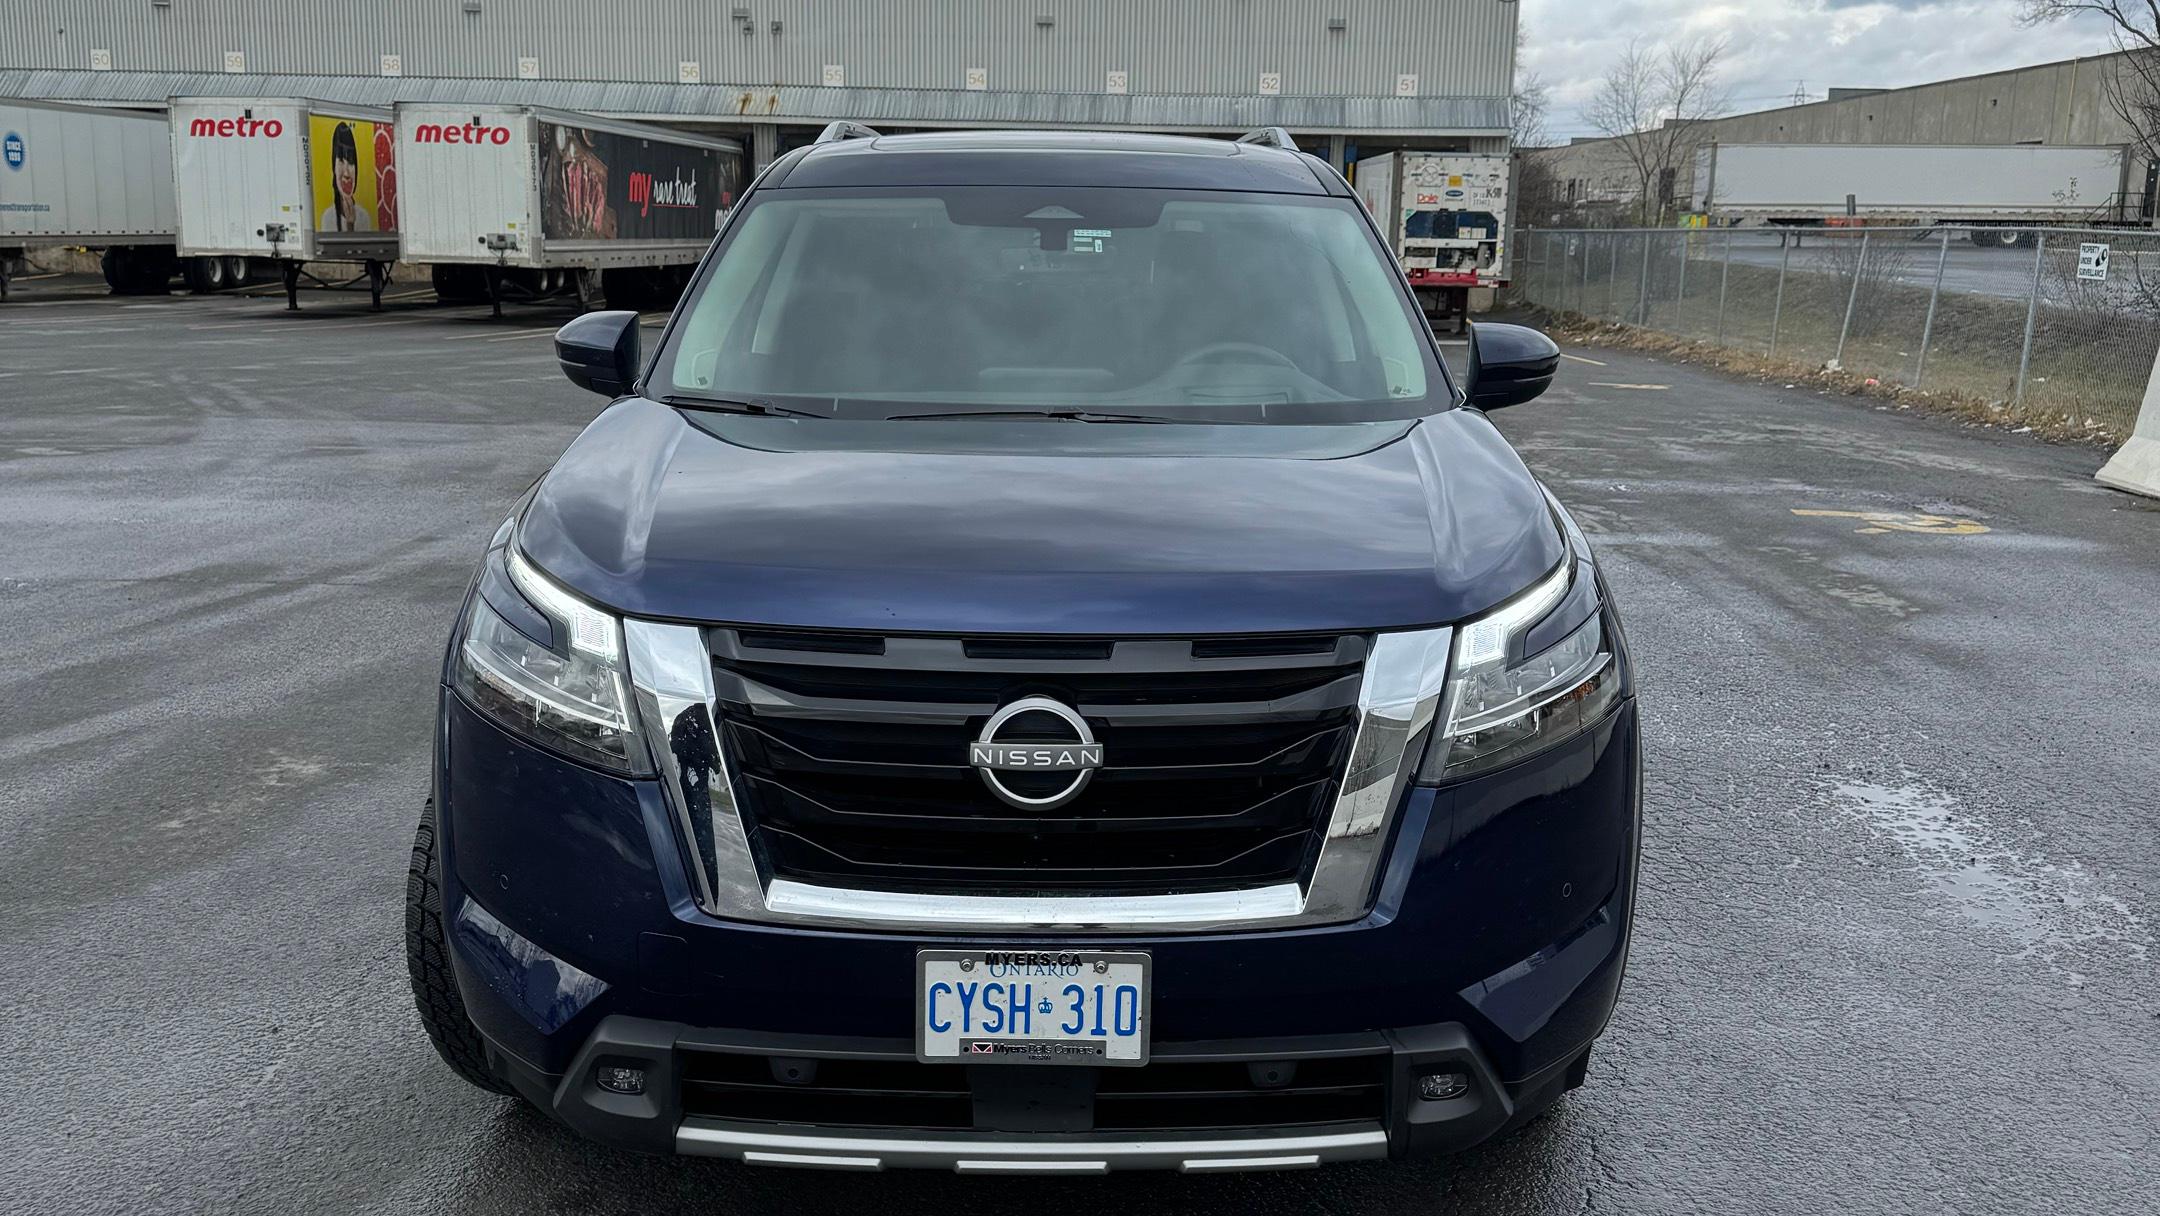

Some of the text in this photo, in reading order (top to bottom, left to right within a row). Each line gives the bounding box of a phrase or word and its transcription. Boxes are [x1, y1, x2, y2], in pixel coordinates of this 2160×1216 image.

[93, 54, 109, 66] 60
[227, 56, 243, 67] 59
[383, 59, 399, 71] 58
[521, 62, 536, 74] 57
[682, 66, 698, 78] 56
[825, 70, 842, 82] 55
[968, 73, 985, 85] 54
[1109, 75, 1126, 87] 53
[1262, 77, 1279, 89] 52
[1400, 79, 1416, 91] 51
[190, 116, 283, 138] metro
[415, 122, 510, 145] metro
[628, 171, 652, 218] my
[675, 166, 698, 206] treat
[974, 748, 1099, 766] NISSAN
[985, 953, 1083, 966] MYERS.CA
[929, 982, 1138, 1036] CYSH 310
[994, 1043, 1027, 1055] Myers
[1054, 1044, 1094, 1055] Corners
